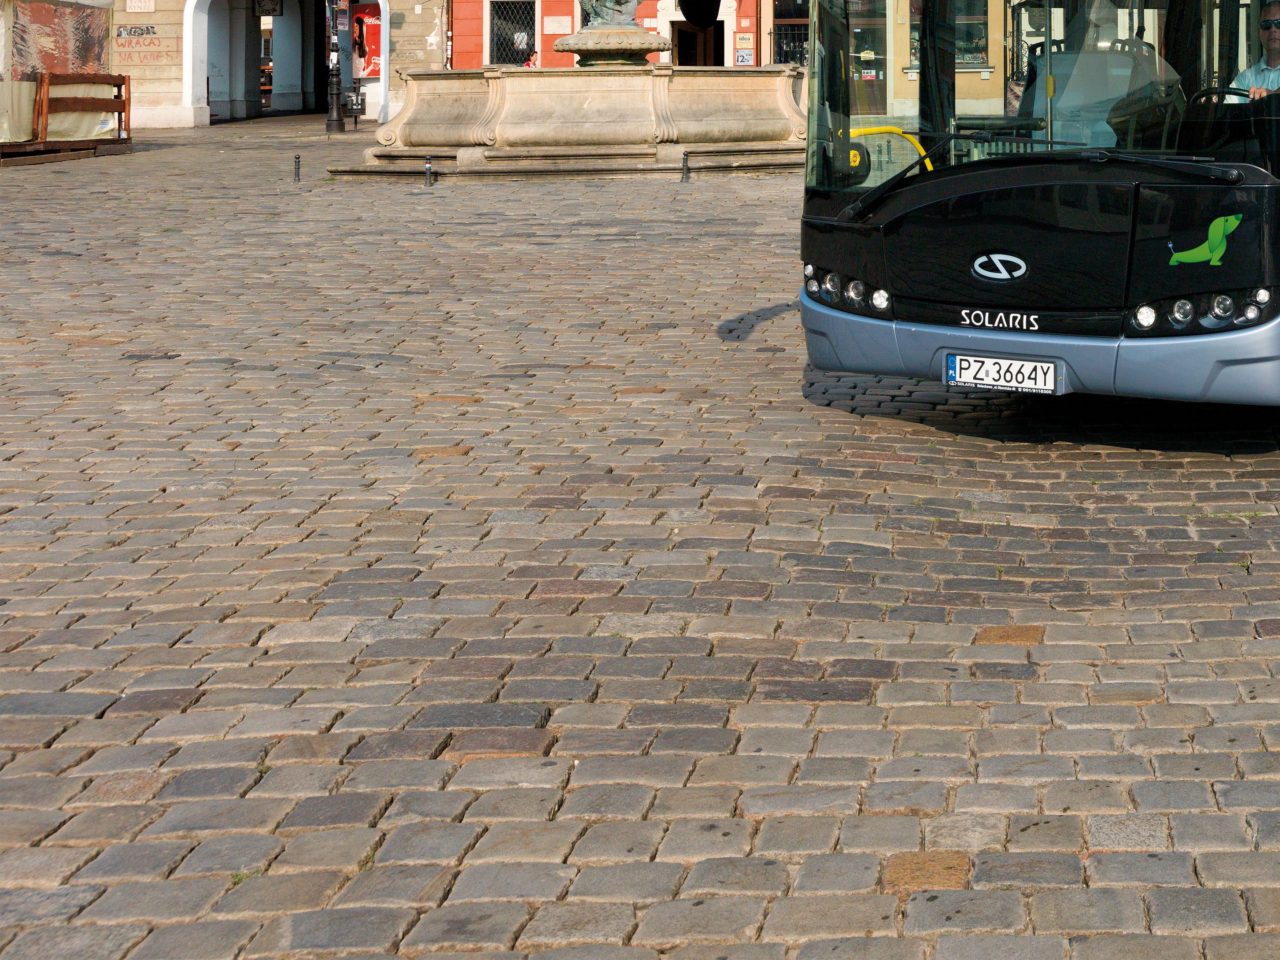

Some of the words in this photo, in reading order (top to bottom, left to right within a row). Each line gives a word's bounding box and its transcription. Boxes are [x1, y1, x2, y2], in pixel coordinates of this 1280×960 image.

[961, 309, 1039, 331] SOLARIS
[959, 358, 985, 381] PZ
[992, 361, 1051, 387] 3664Y
